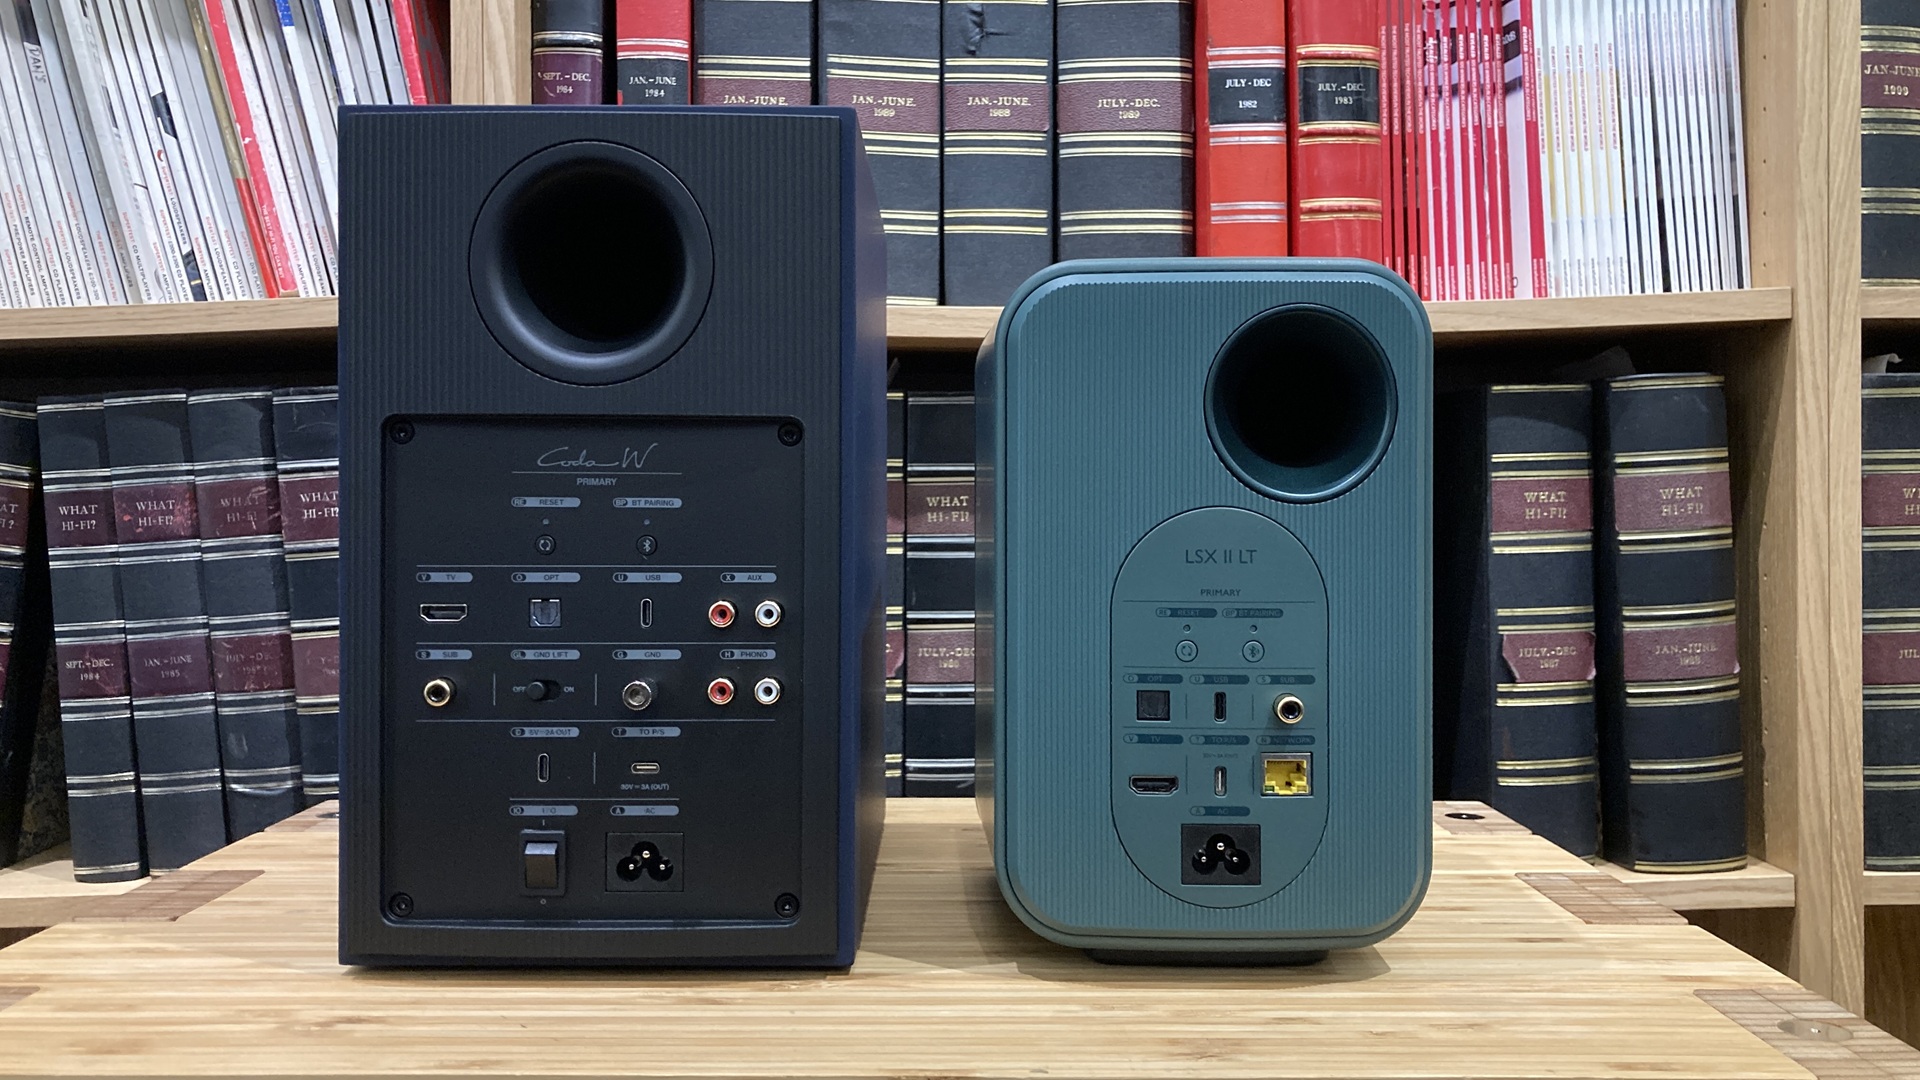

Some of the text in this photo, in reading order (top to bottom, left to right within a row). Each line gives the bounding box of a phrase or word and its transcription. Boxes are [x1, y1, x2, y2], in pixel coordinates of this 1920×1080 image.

[556, 85, 574, 93] 1984
[645, 88, 665, 98] 1984
[1238, 100, 1257, 108] 1982
[1334, 96, 1353, 104] 1983
[65, 252, 81, 300] LOUDSPEAKERS
[537, 443, 658, 468] Coda W
[576, 477, 618, 486] PRIMARY
[300, 491, 338, 502] WHAT
[1524, 491, 1567, 503] WHAT
[1660, 487, 1703, 499] WHAT
[136, 500, 175, 511] WHAT
[644, 499, 674, 507] PAIRING
[927, 496, 969, 506] WHAT
[58, 504, 98, 515] WHAT
[303, 507, 339, 519] HI-FI?
[1525, 508, 1567, 519] HI-FI?
[1661, 503, 1703, 516] HI-FI?
[138, 516, 174, 527] HI-FI?
[927, 511, 969, 523] HI-FI?
[62, 521, 96, 531] HI-FI?
[1185, 549, 1257, 564] LSX II LT
[80, 673, 100, 681] 1984
